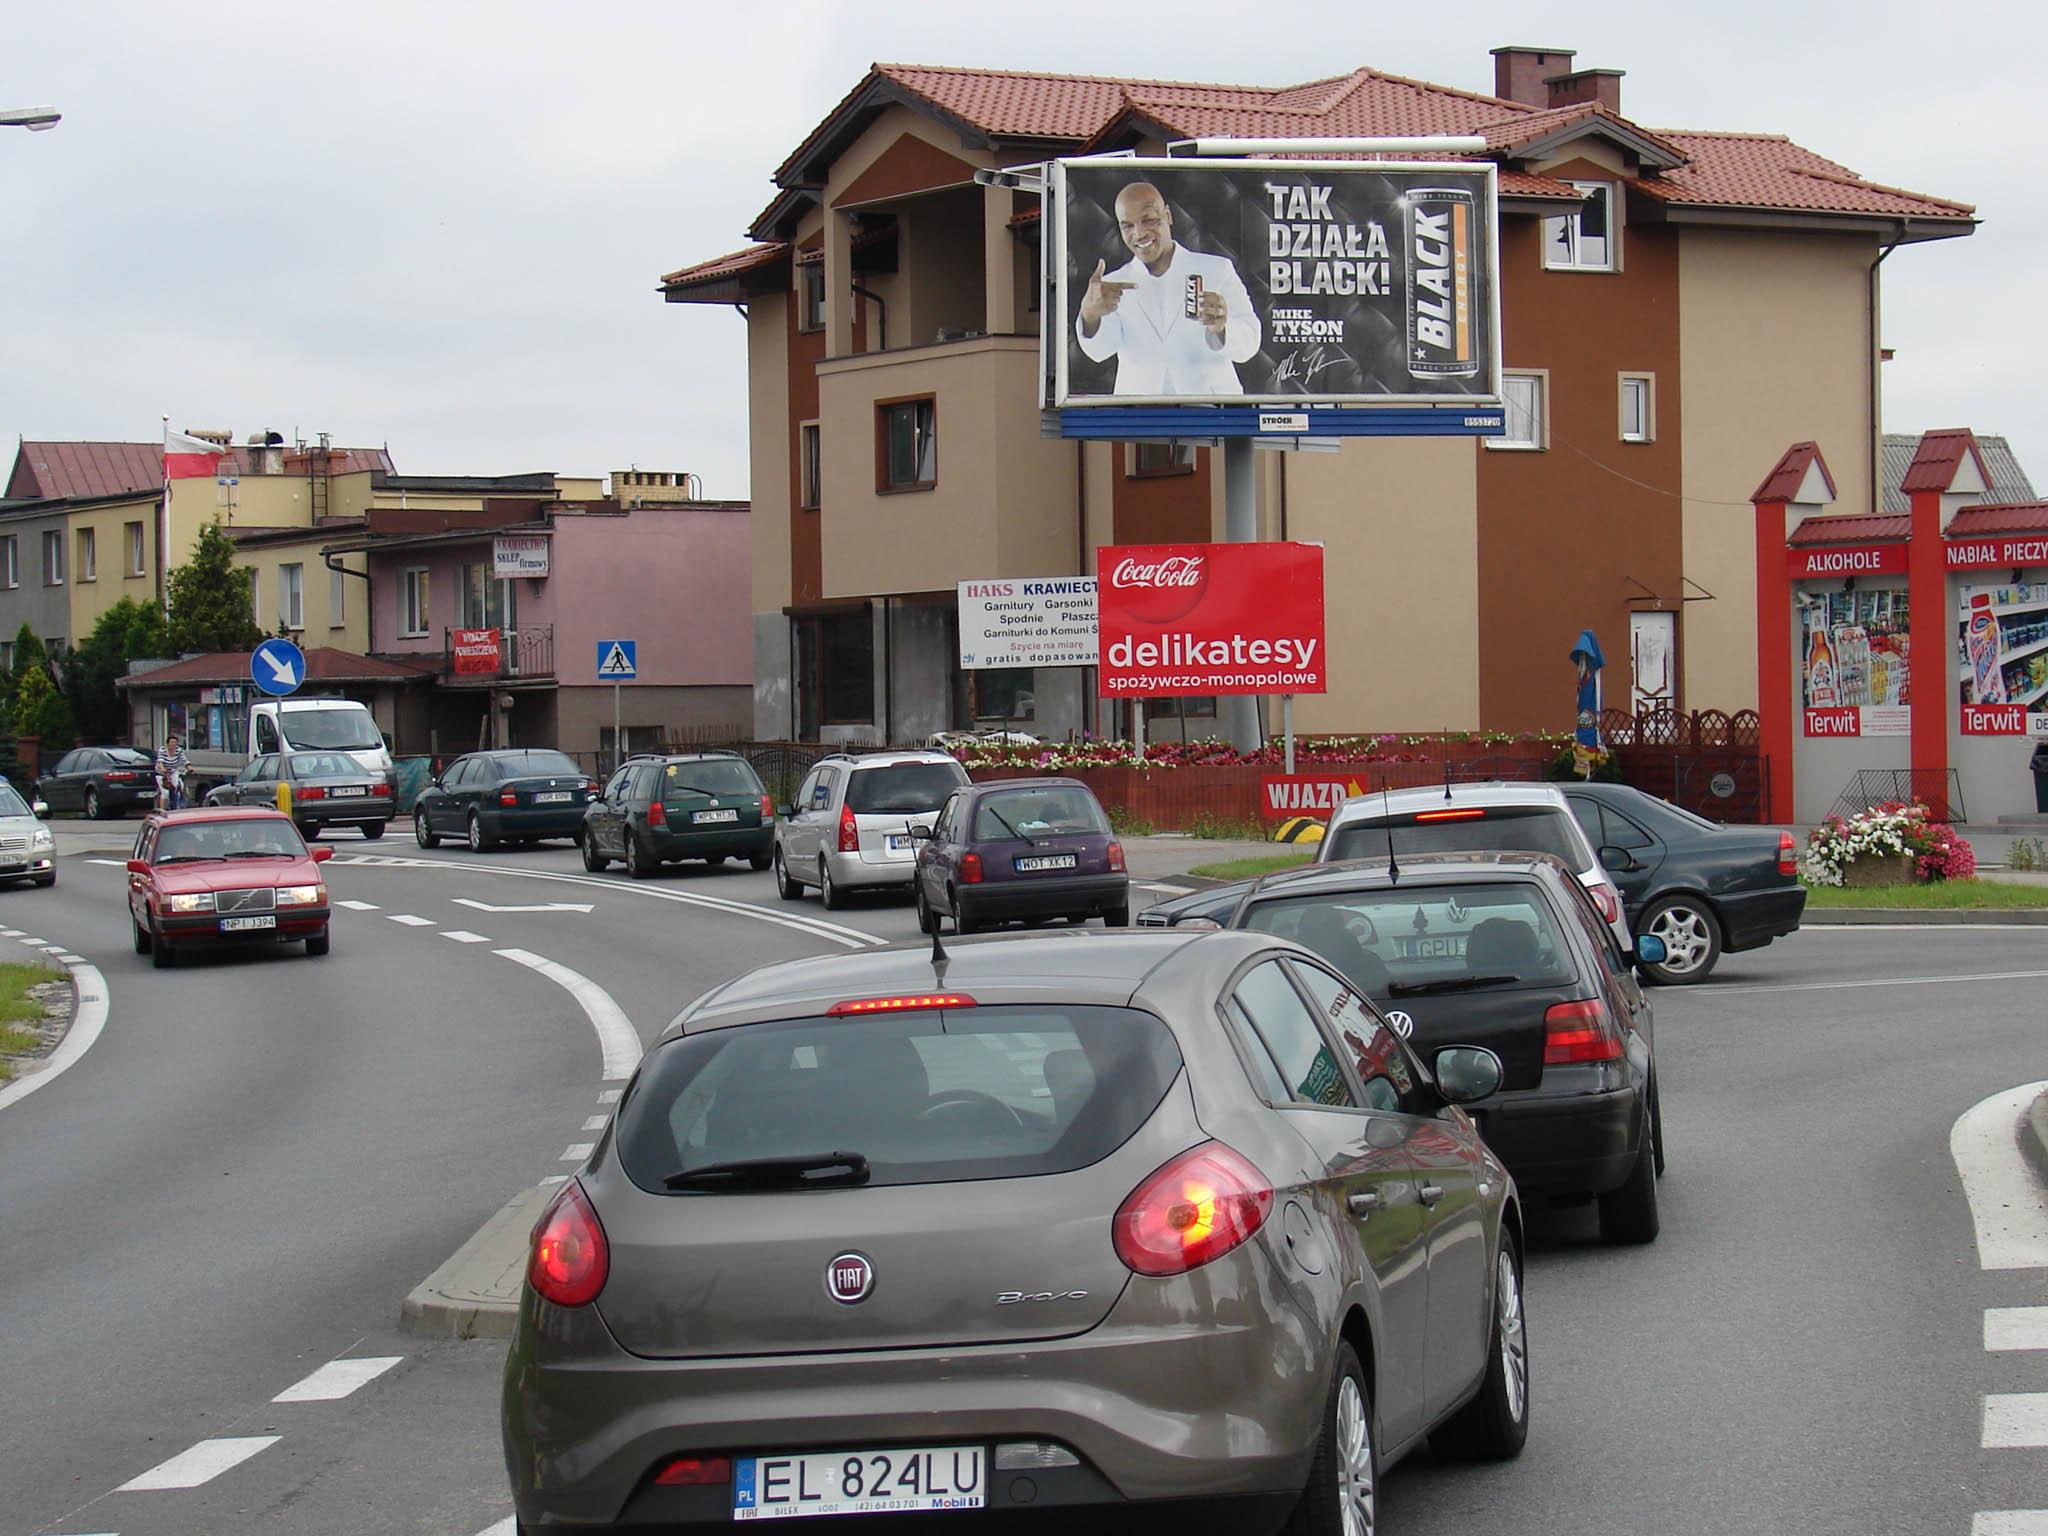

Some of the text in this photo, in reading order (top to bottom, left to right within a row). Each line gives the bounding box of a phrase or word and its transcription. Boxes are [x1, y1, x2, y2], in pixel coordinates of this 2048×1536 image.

[1267, 186, 1334, 220] TAK
[1269, 223, 1390, 258] DZIAŁA
[1269, 261, 1390, 296] BLACK!
[1415, 207, 1451, 350] BLACK
[1455, 249, 1468, 323] ENERGY
[1272, 309, 1312, 319] MIKE
[1272, 320, 1344, 336] TYSON
[497, 552, 519, 563] SKLEP
[520, 559, 546, 570] firmowy
[1806, 551, 1881, 572] ALKOHOLE
[1947, 546, 1997, 565] NABIAŁ
[1112, 556, 1204, 588] Coca-Cola
[967, 583, 1014, 598] HAKS
[984, 598, 1093, 612] Garnitury Garsonki
[1000, 614, 1044, 625] Spodnie
[984, 628, 1033, 638] Garniturki
[1036, 626, 1048, 636] do
[1051, 625, 1089, 636] Komuni
[1010, 643, 1040, 652] Szycie
[1058, 641, 1084, 650] miarę
[1108, 634, 1317, 670] delikatesy
[986, 653, 1021, 665] gratis
[1108, 671, 1317, 691] spożywczo-monopolowe
[1806, 710, 1856, 734] Terwit
[1965, 707, 2021, 731] Terwit
[1267, 783, 1347, 809] WJAZD
[1023, 856, 1074, 869] WOT XK12
[837, 1267, 862, 1289] FIAT
[998, 1290, 1089, 1305] Bravo
[763, 1451, 978, 1504] EL 824LU
[739, 1490, 754, 1502] PL
[742, 1509, 758, 1518] FIAT
[932, 1498, 966, 1508] Mobil
